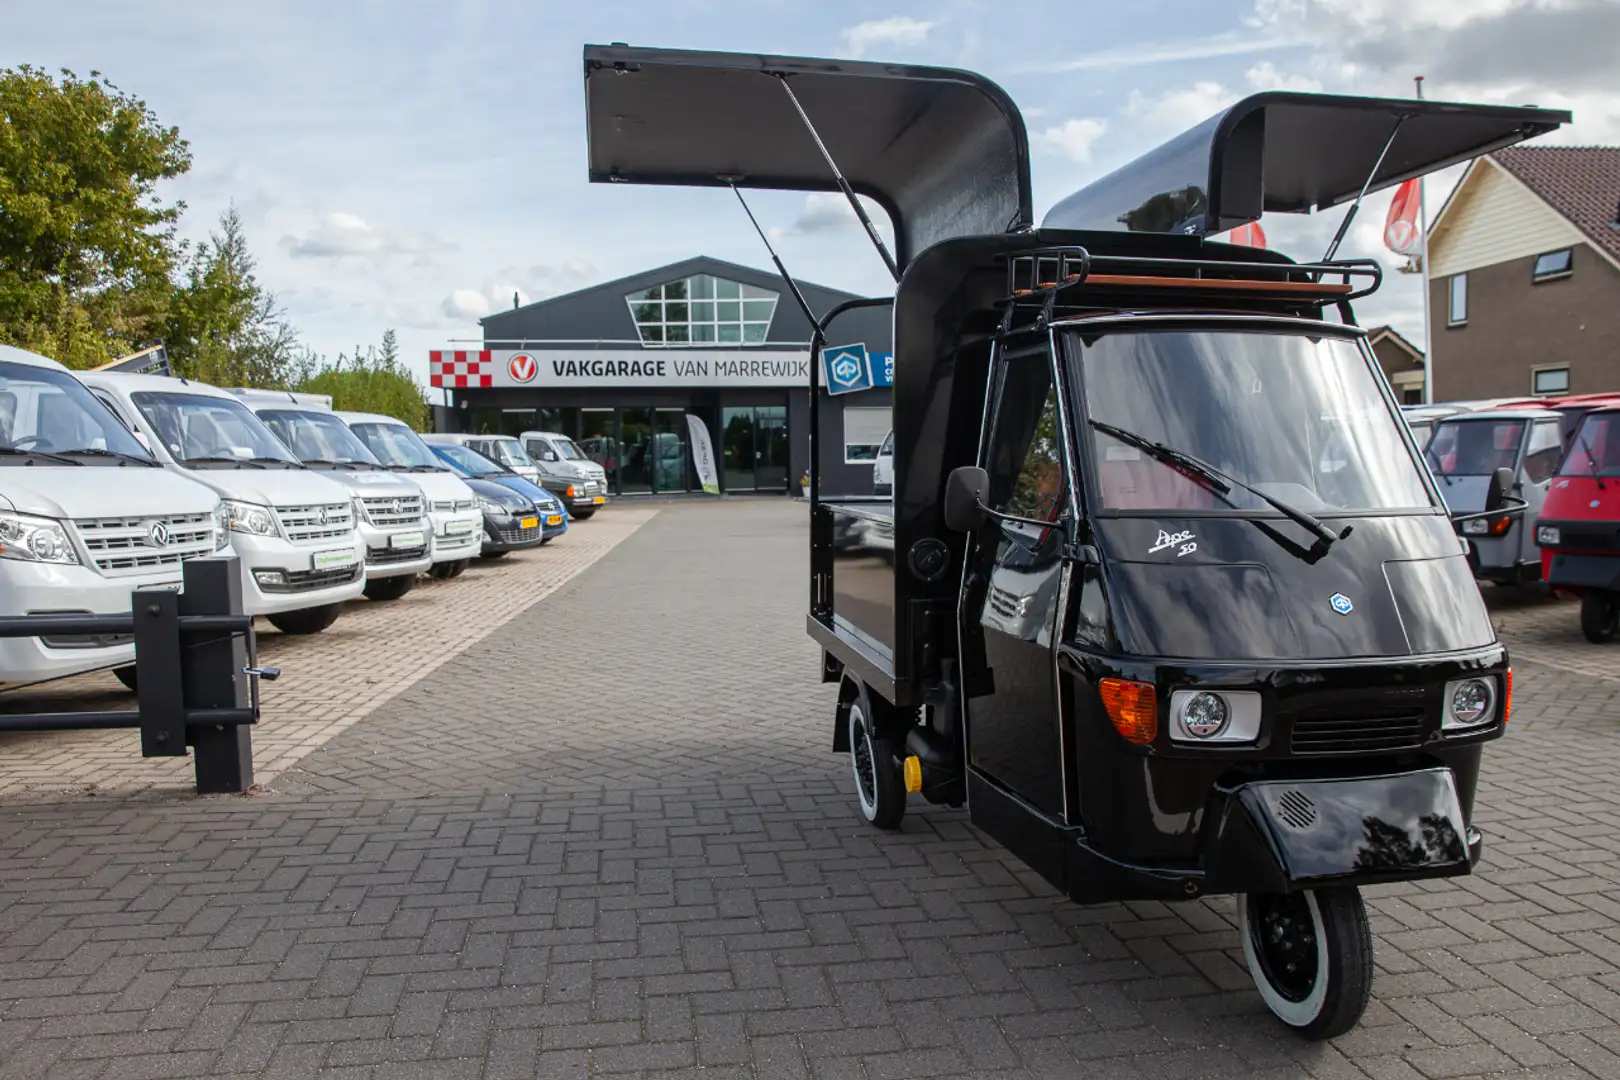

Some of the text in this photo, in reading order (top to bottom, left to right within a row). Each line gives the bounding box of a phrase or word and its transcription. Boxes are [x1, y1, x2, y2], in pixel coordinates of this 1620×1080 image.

[513, 355, 808, 379] V VAKGARAGE VAN MARREWIJK
[1150, 529, 1196, 552] Ape
[1178, 542, 1197, 556] 50
